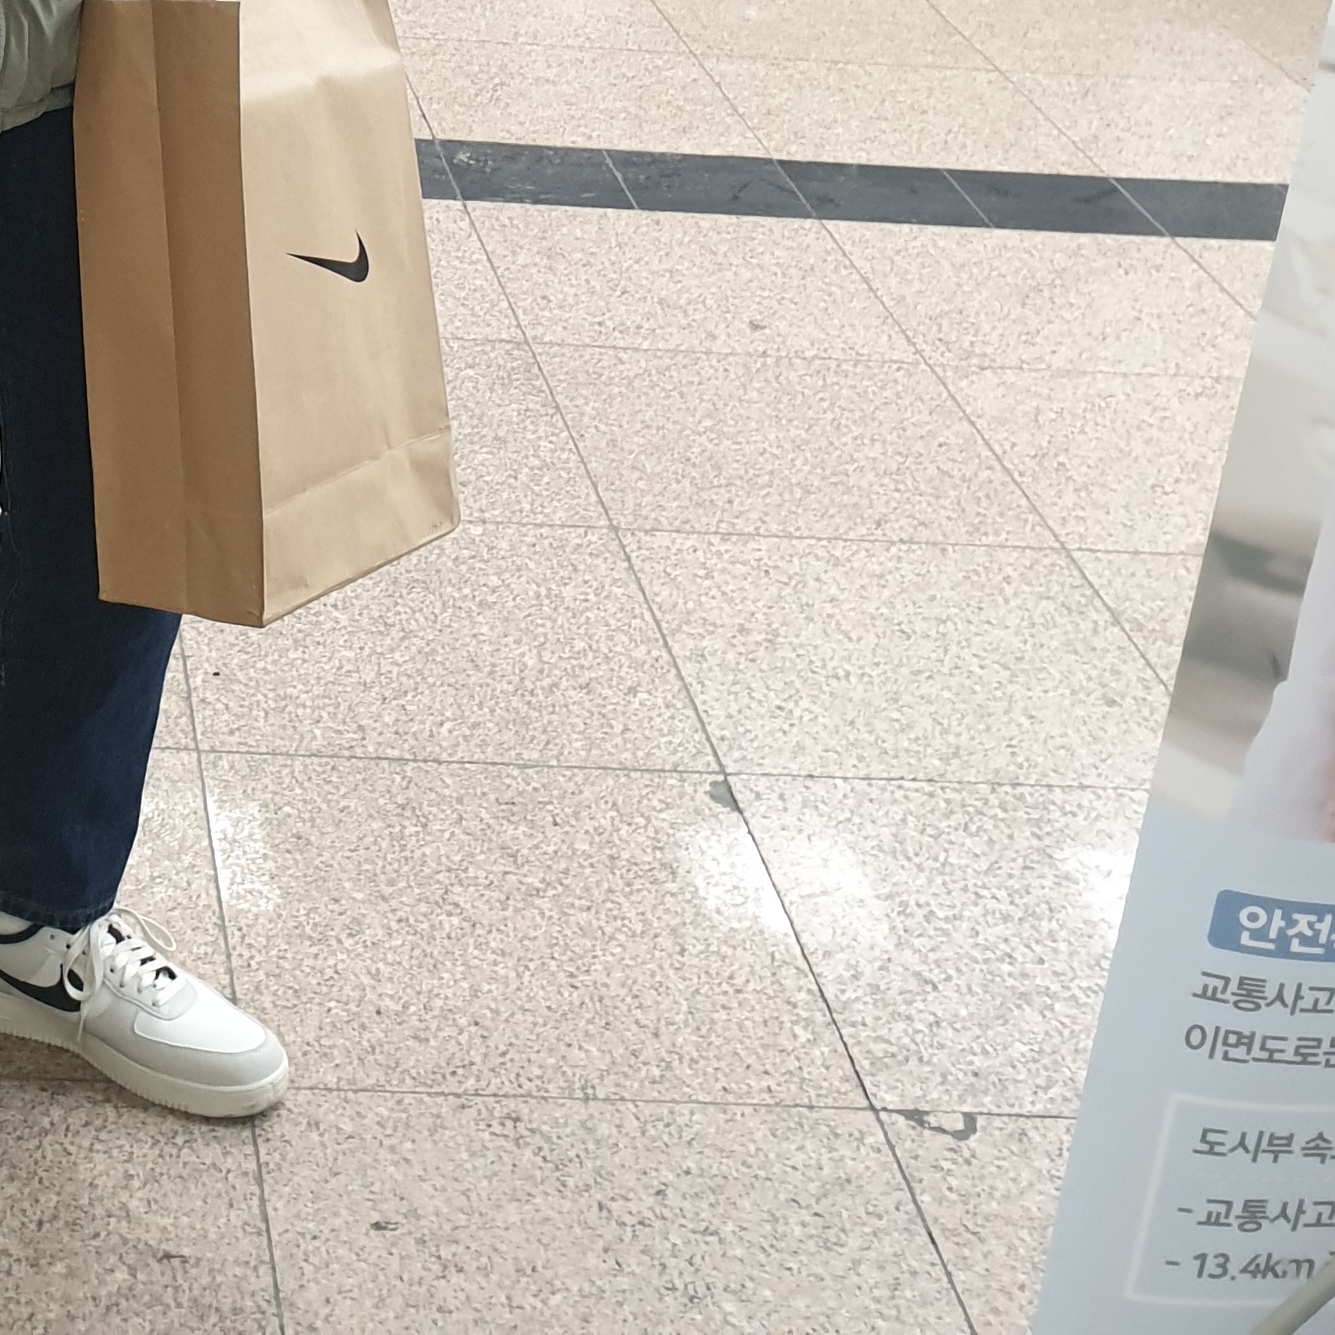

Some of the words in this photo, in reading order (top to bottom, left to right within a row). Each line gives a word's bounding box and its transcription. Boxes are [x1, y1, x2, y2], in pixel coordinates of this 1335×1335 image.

[1238, 905, 1335, 955] 안전
[1191, 970, 1335, 1016] 교통사고
[1192, 1126, 1295, 1164] 도시부
[1300, 1131, 1335, 1165] 속
[1196, 1198, 1335, 1233] 교통사고
[1192, 1251, 1316, 1282] 13.4km
